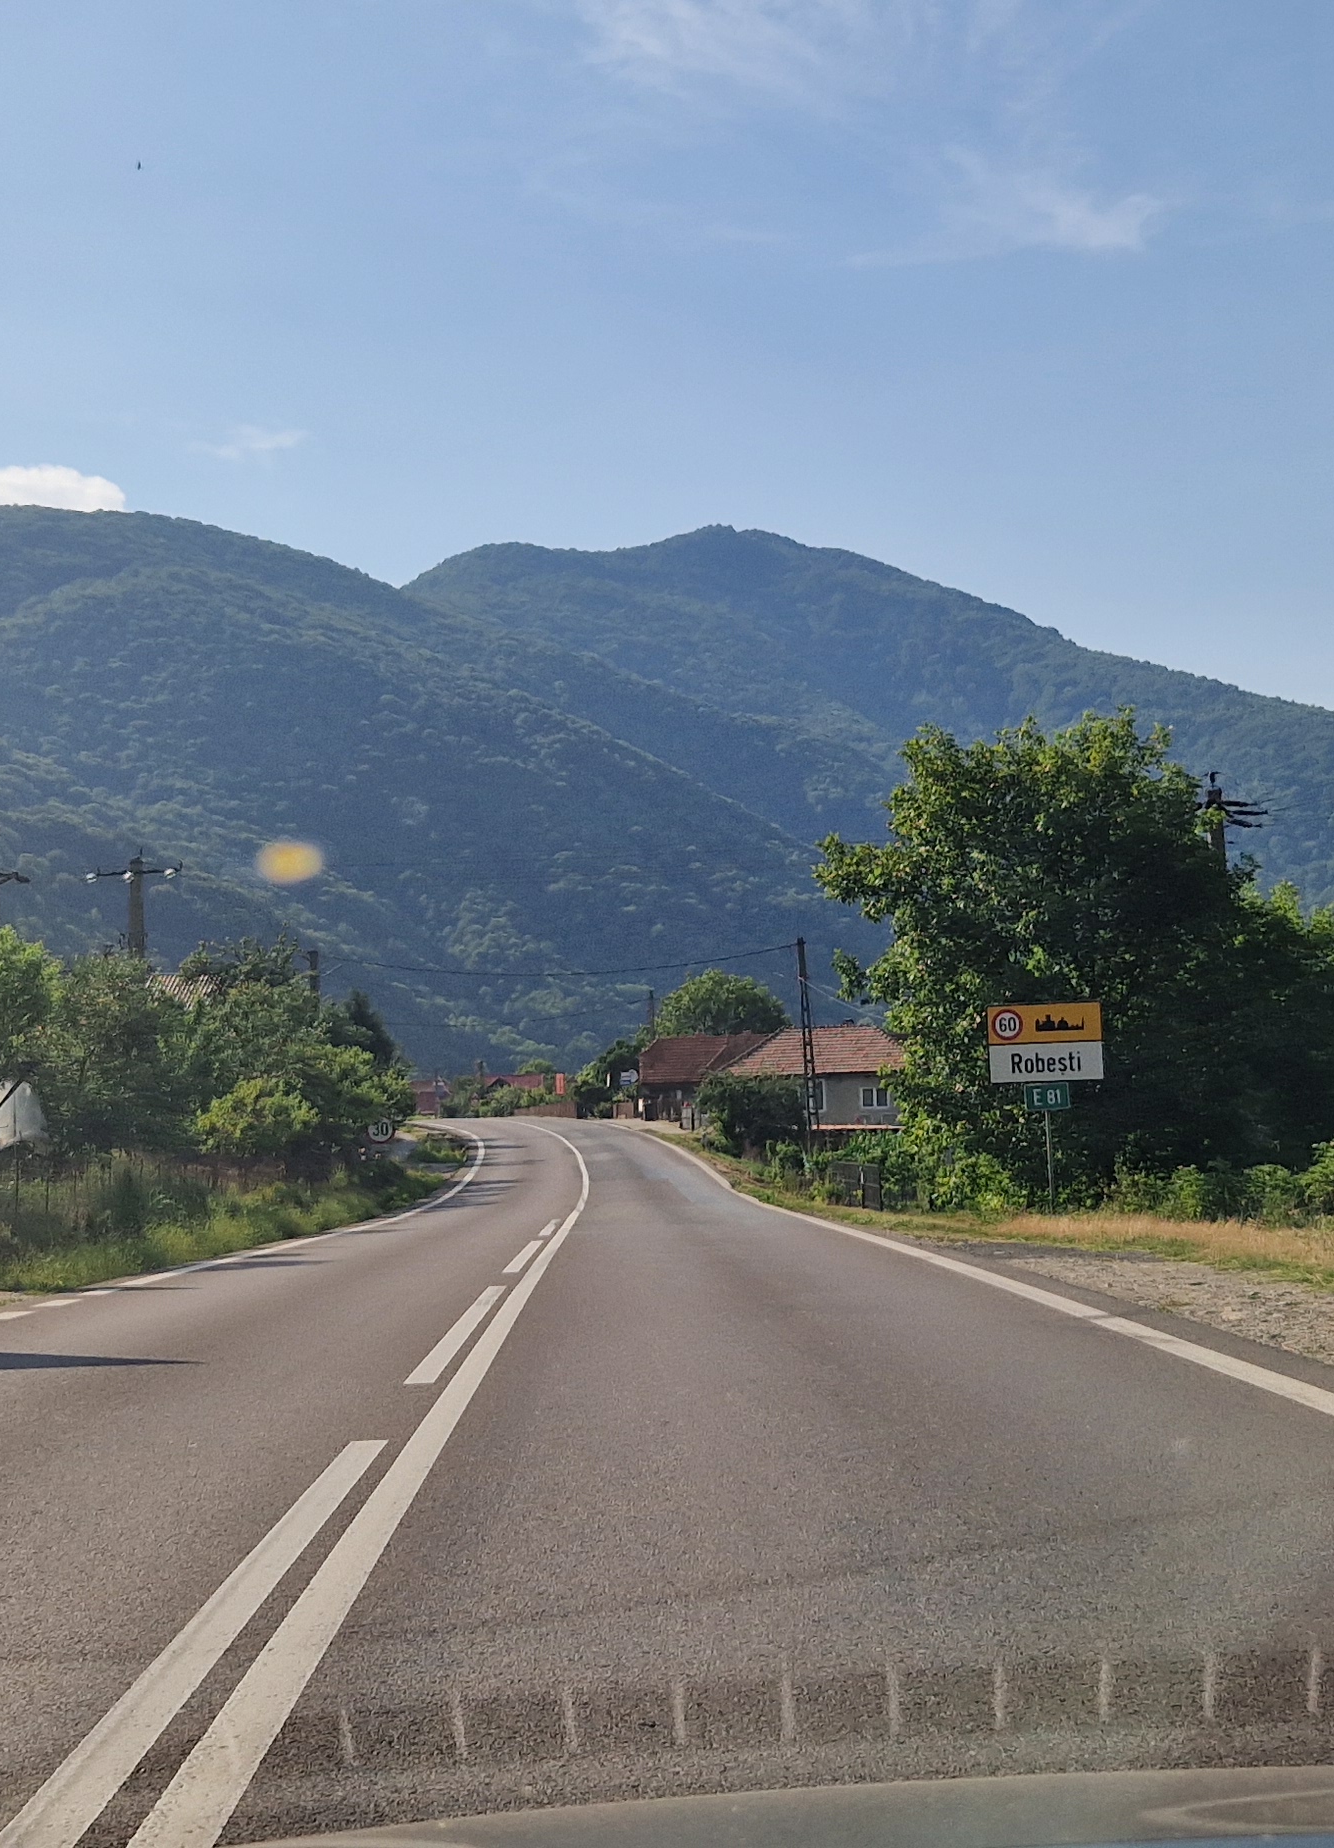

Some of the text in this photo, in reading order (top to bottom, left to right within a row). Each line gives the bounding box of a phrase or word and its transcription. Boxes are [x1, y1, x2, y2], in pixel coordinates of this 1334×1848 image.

[998, 1016, 1017, 1033] 60
[1011, 1051, 1082, 1075] Robești
[1032, 1088, 1061, 1106] E 81
[372, 1121, 388, 1136] 30
